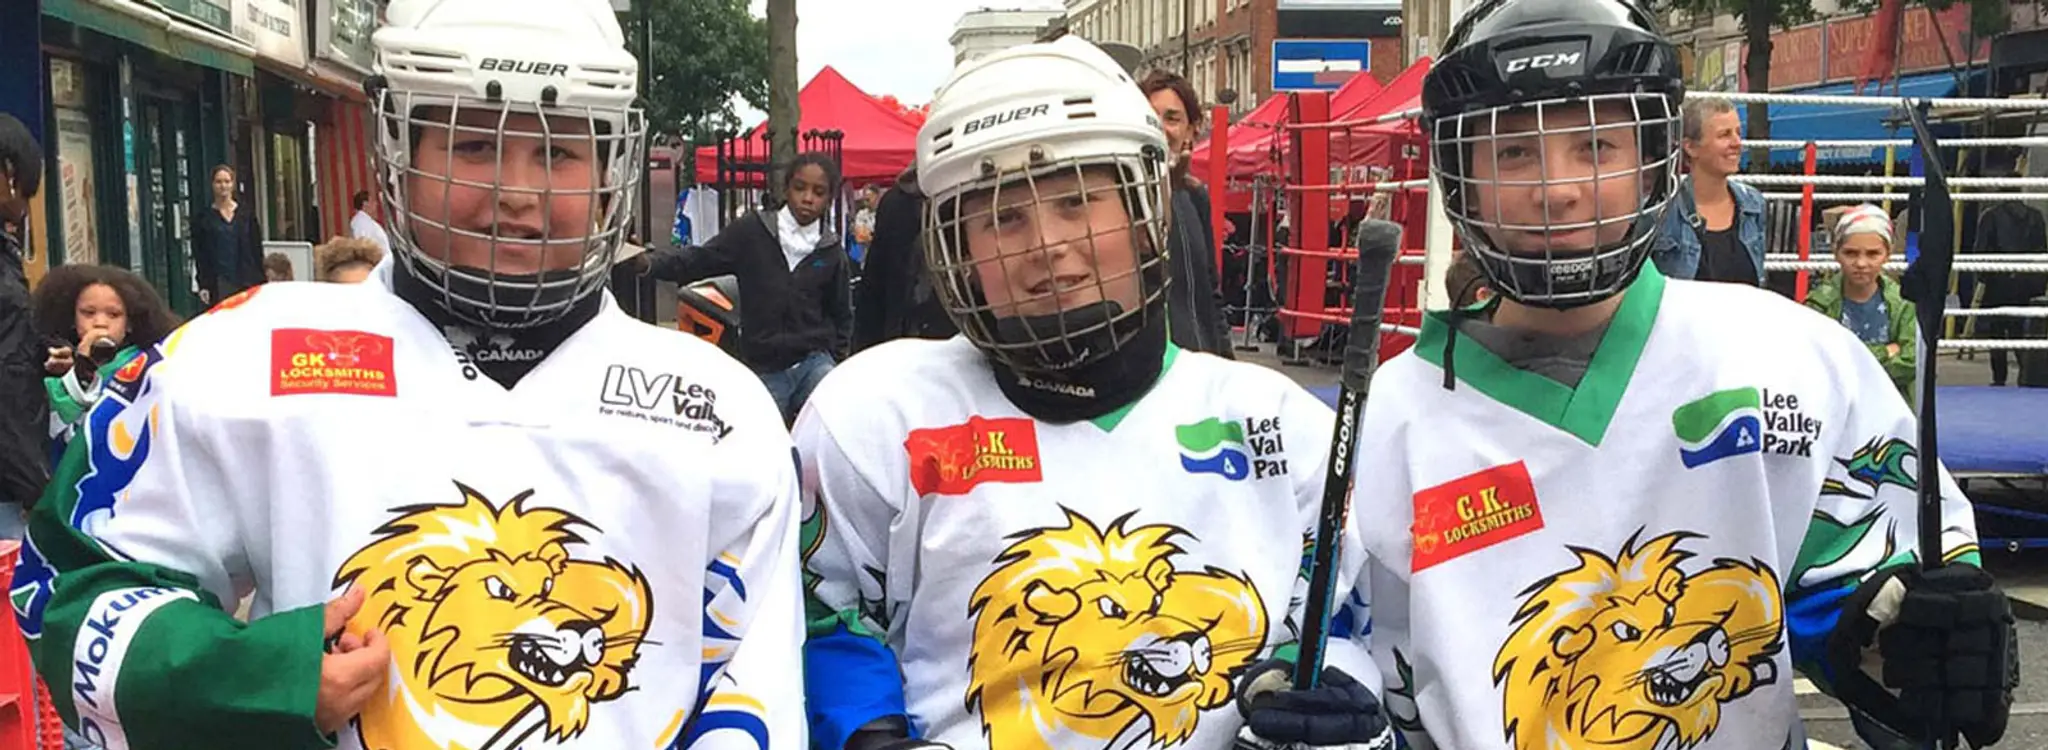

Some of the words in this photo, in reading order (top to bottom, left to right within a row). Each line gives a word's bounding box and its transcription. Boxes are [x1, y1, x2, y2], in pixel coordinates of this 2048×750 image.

[479, 57, 568, 79] BAUER
[1506, 52, 1581, 73] CCM
[963, 103, 1050, 135] BAUER
[291, 352, 326, 368] GK
[476, 349, 545, 362] CANADA
[281, 367, 385, 381] LOCKSMITHS
[600, 364, 674, 410] LV
[673, 375, 717, 404] Lee
[1033, 379, 1096, 398] CANADA
[1762, 387, 1799, 411] Lee
[1762, 410, 1823, 441] Valley
[1761, 432, 1813, 458] Park
[1455, 485, 1511, 522] G.K.
[1442, 502, 1535, 546] LOCKSMITHS
